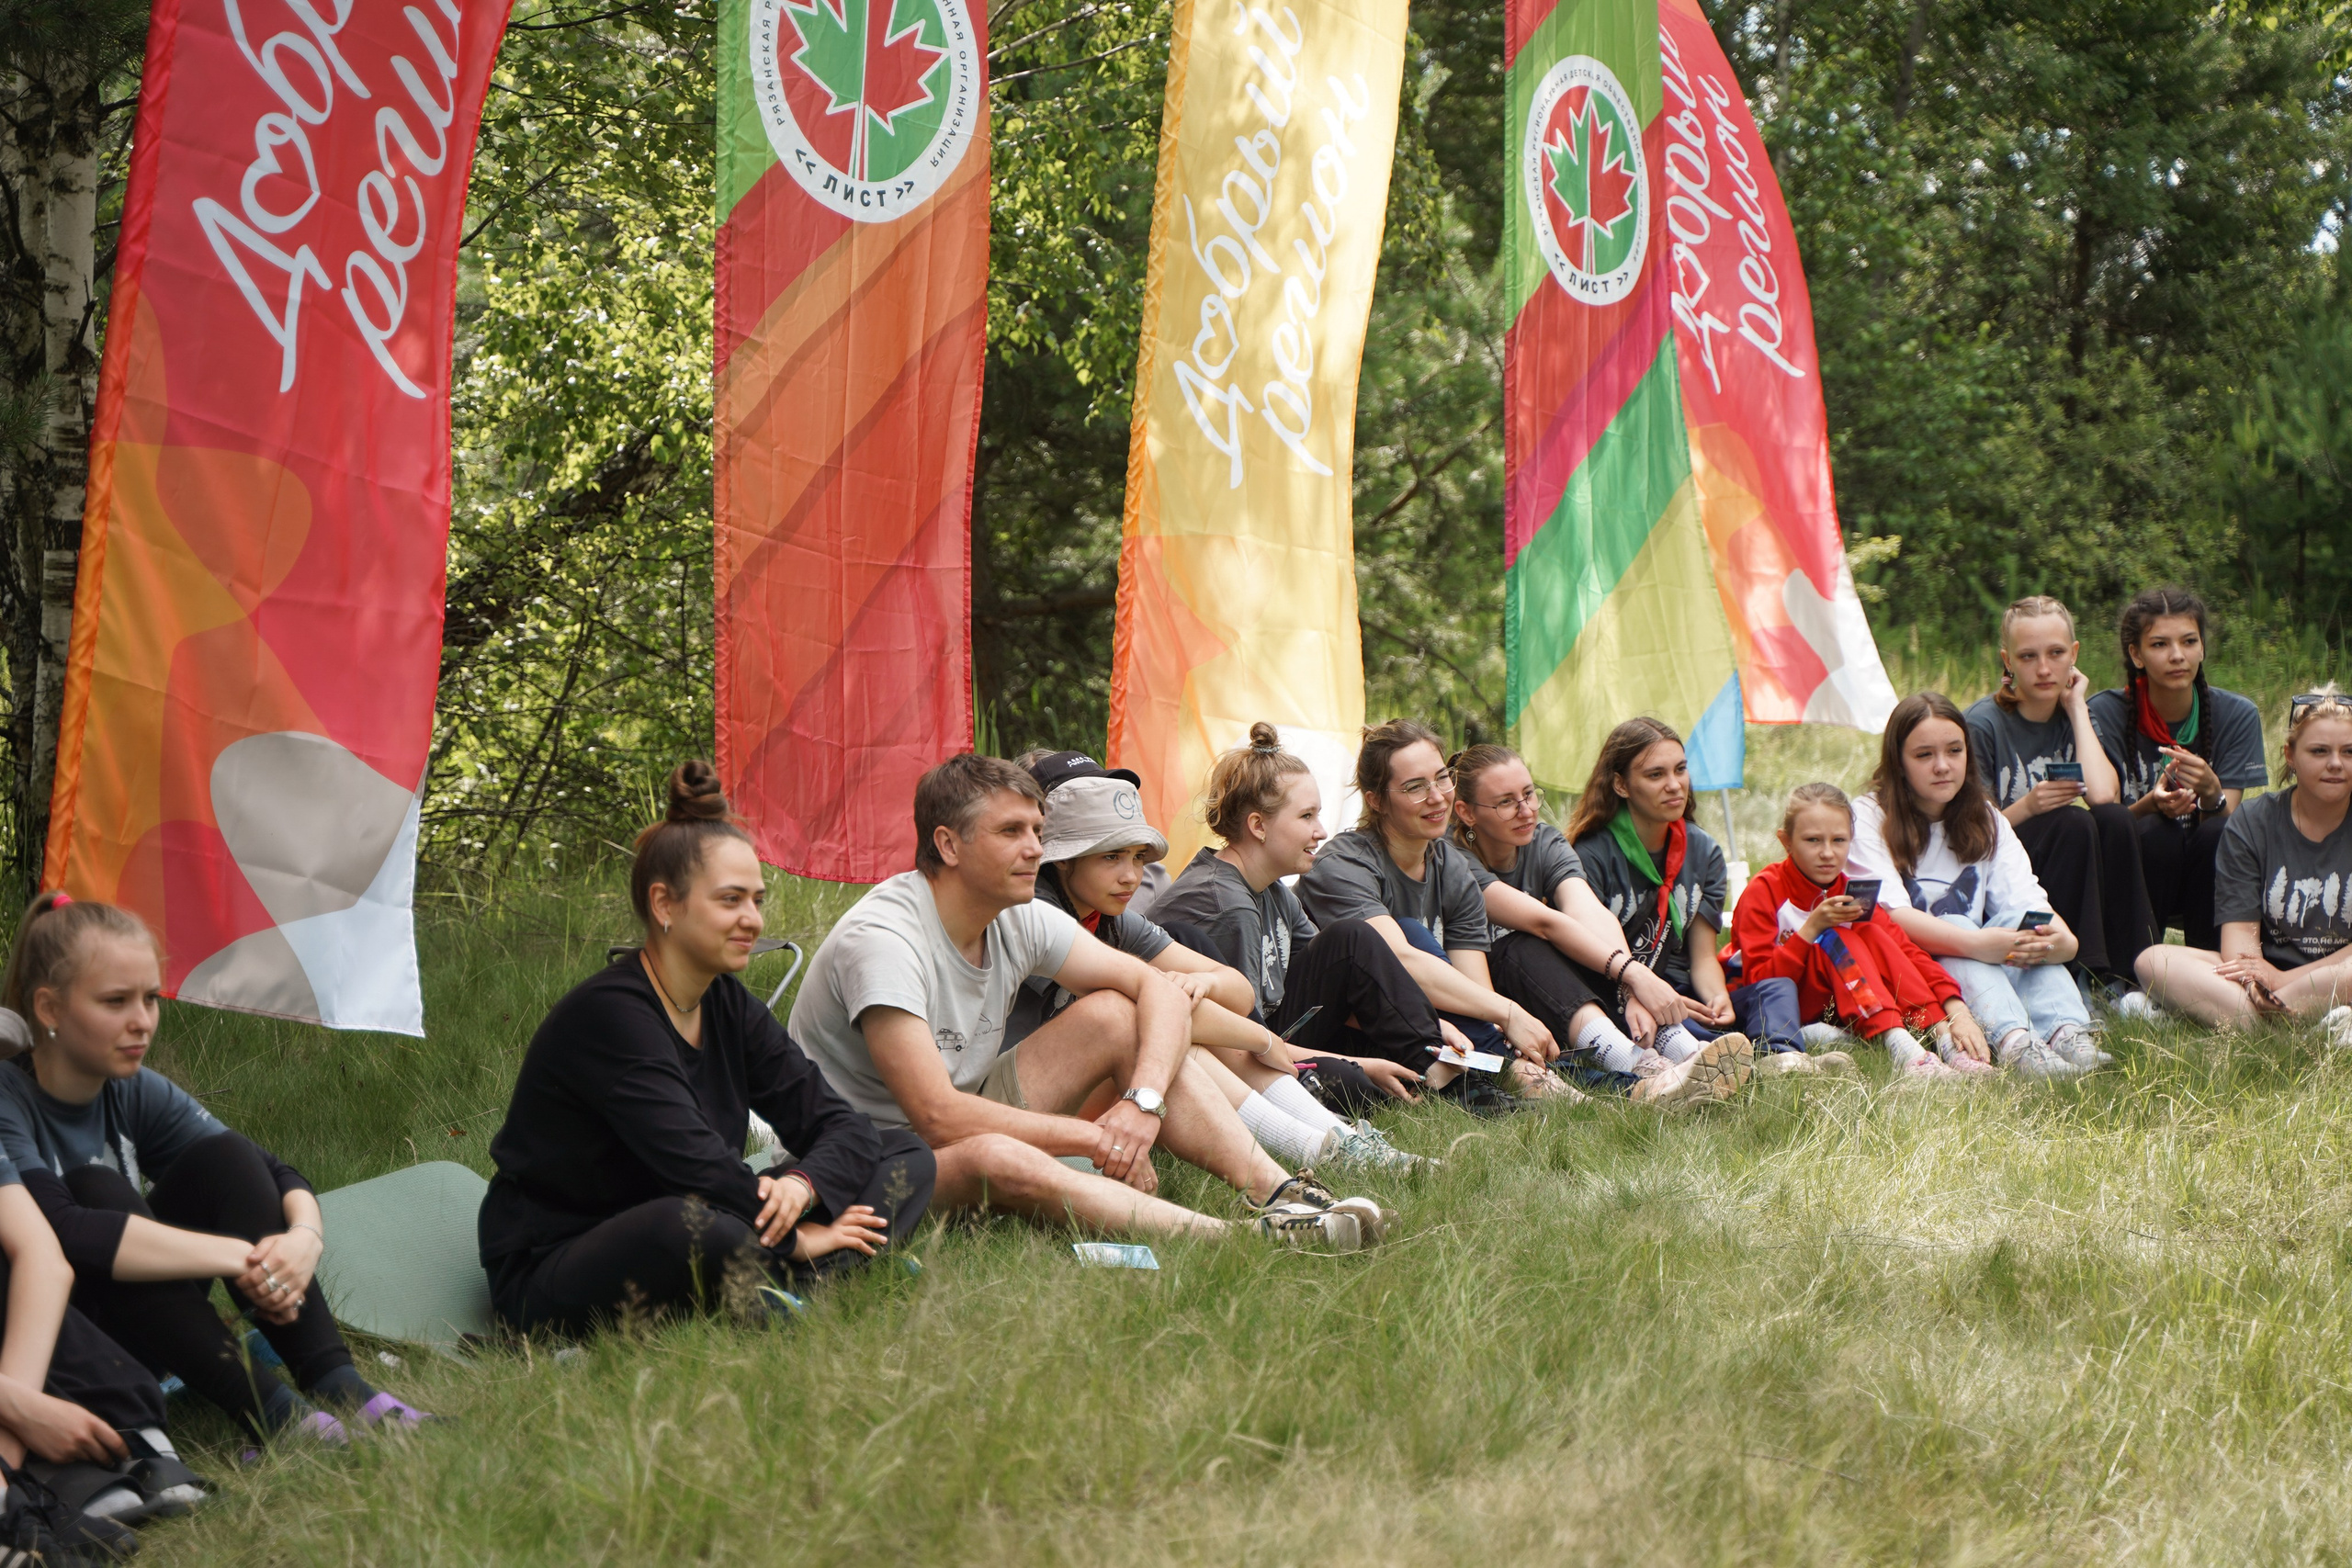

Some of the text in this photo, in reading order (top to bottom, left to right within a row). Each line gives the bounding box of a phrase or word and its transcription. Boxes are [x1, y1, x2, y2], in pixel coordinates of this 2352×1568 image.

[192, 0, 371, 393] Добр
[341, 0, 461, 399] реги
[763, 18, 968, 168] РЯЗАНСКАЯ ОРГАНИЗАЦИЯ
[1173, 1, 1303, 489] Добрый
[1698, 73, 1806, 378] регион
[1261, 73, 1369, 477] регион
[1648, 942, 1664, 970] МИССАР
[1660, 1030, 1681, 1054] ОЛЕНО
